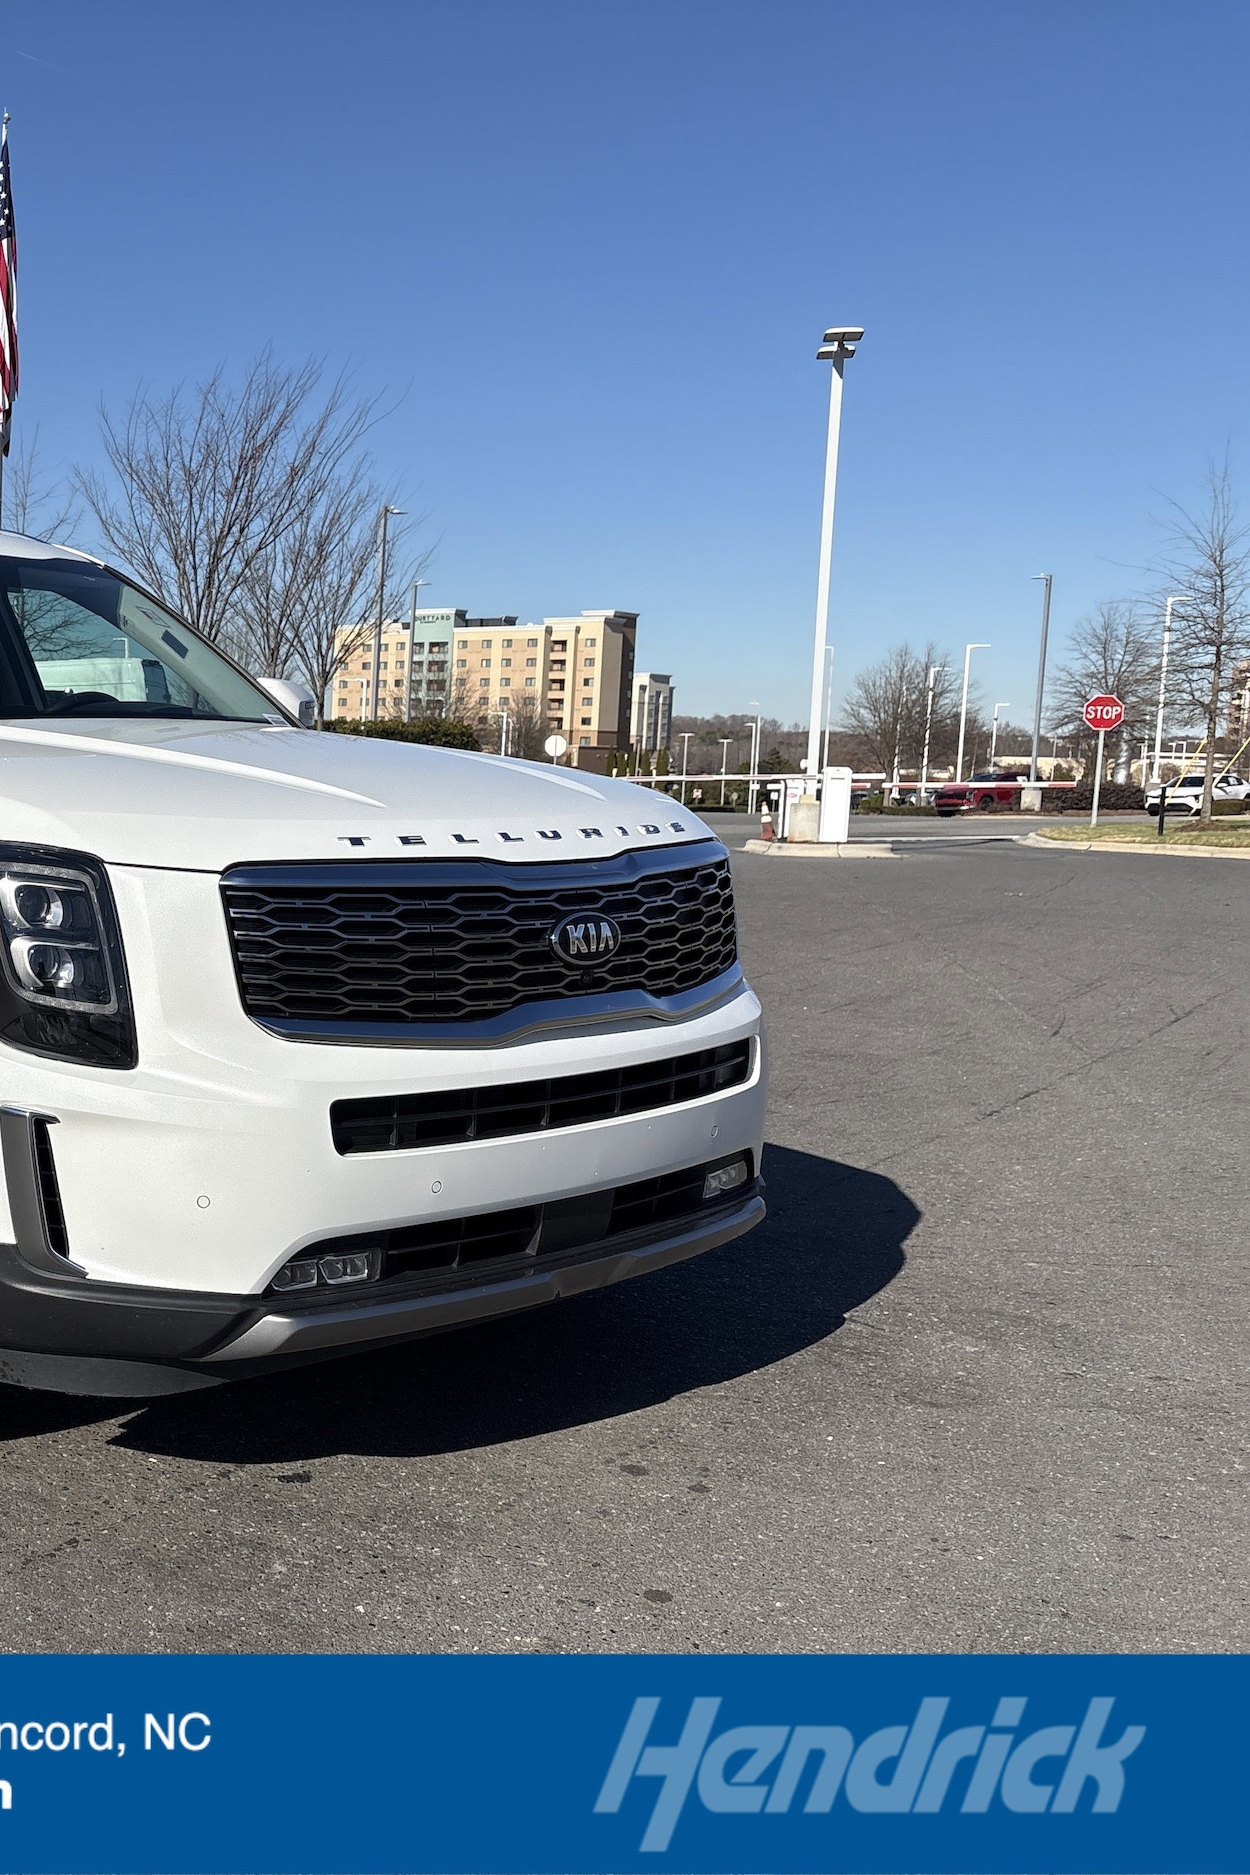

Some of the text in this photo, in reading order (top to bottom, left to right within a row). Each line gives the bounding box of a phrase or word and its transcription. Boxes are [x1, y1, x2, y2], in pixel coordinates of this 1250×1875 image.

[1086, 705, 1122, 720] STOP
[336, 821, 687, 848] TELLURIDE
[566, 921, 615, 955] KIA
